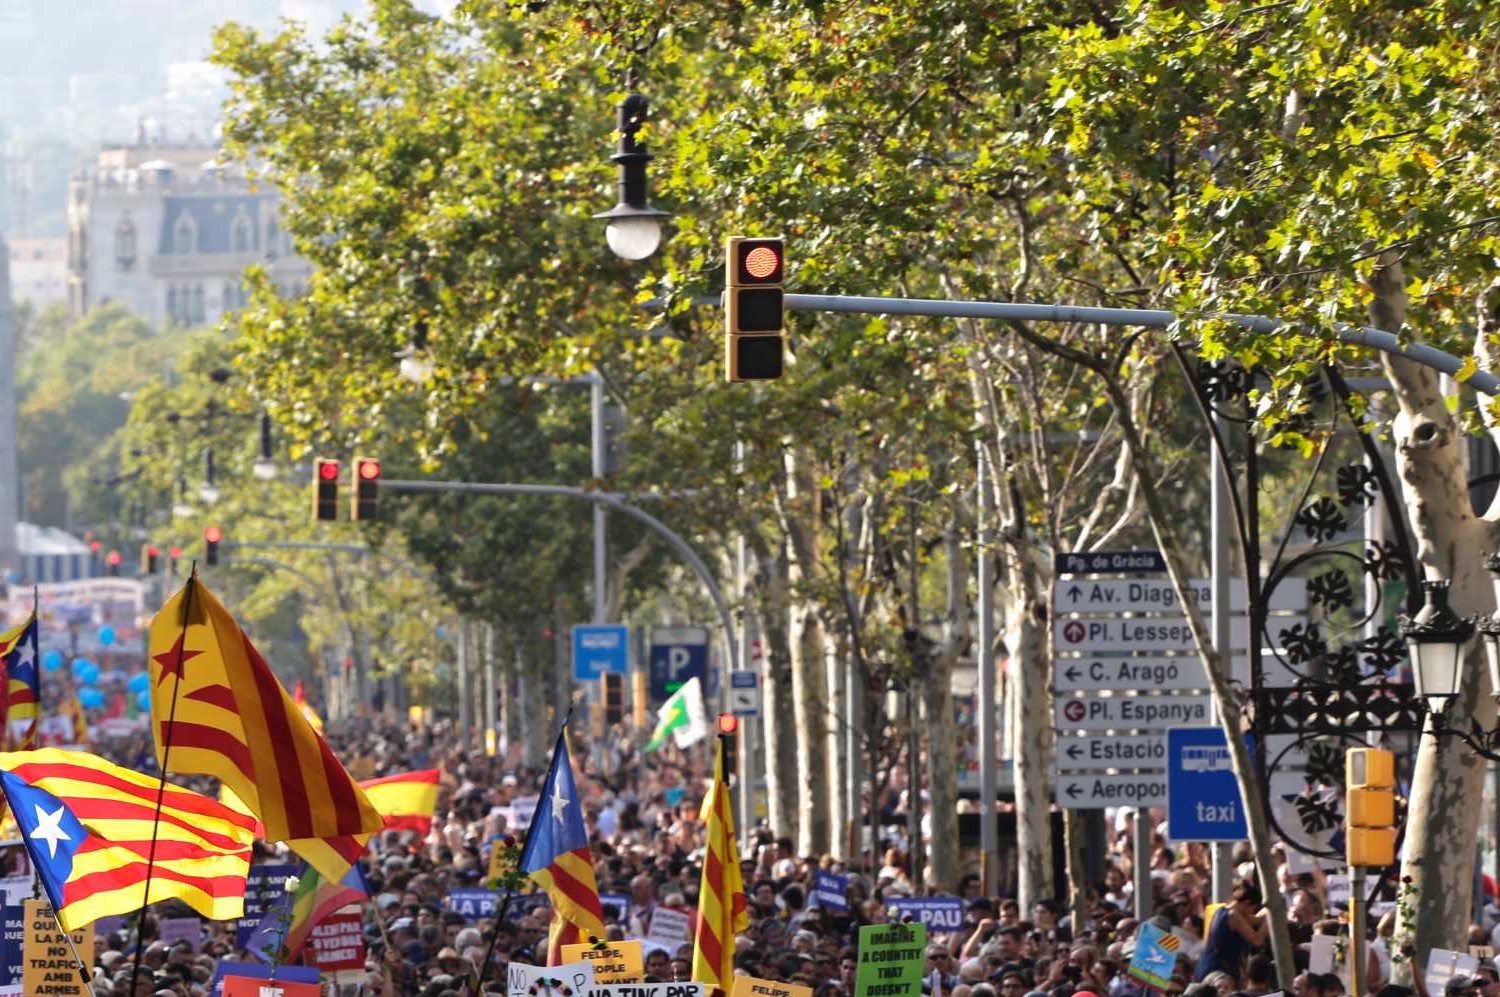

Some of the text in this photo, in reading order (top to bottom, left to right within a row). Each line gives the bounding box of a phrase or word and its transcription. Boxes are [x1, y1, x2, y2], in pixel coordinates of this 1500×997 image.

[1068, 554, 1155, 569] Pg. de Gràcia
[1090, 587, 1121, 601] Av.
[1090, 624, 1192, 644] Pl. Lessep
[669, 646, 690, 677] P
[1090, 662, 1178, 684] C. Aragó
[1090, 703, 1205, 722] Pl. Espanya
[1090, 741, 1164, 759] Estació
[1092, 781, 1166, 801] Aeropor
[1198, 802, 1235, 821] taxi
[870, 930, 915, 944] IMAGINE
[862, 948, 921, 962] A COUNTRY
[878, 967, 904, 979] THAT
[866, 983, 910, 997] DOESN'T
